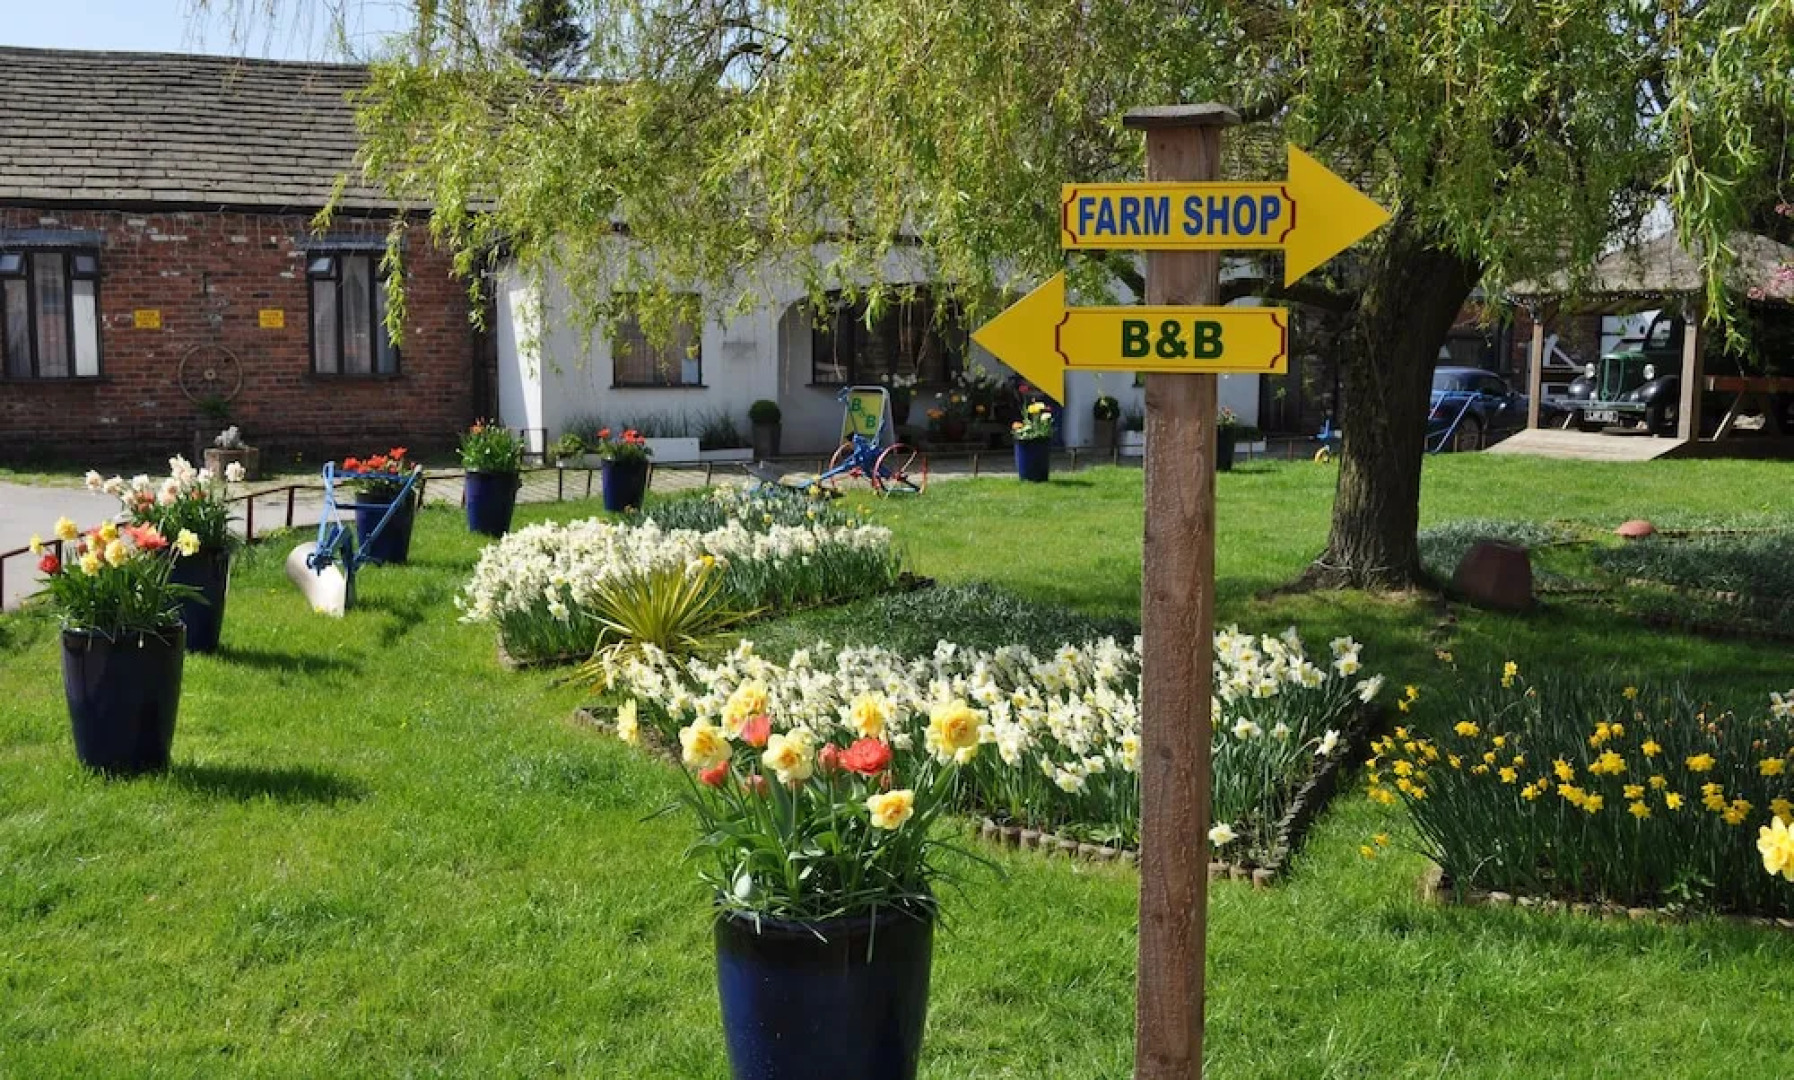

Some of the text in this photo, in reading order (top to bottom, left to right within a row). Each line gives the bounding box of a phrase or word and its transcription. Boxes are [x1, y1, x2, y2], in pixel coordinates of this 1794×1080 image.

[1078, 195, 1281, 236] FARM SHOP
[1121, 319, 1223, 359] B&B
